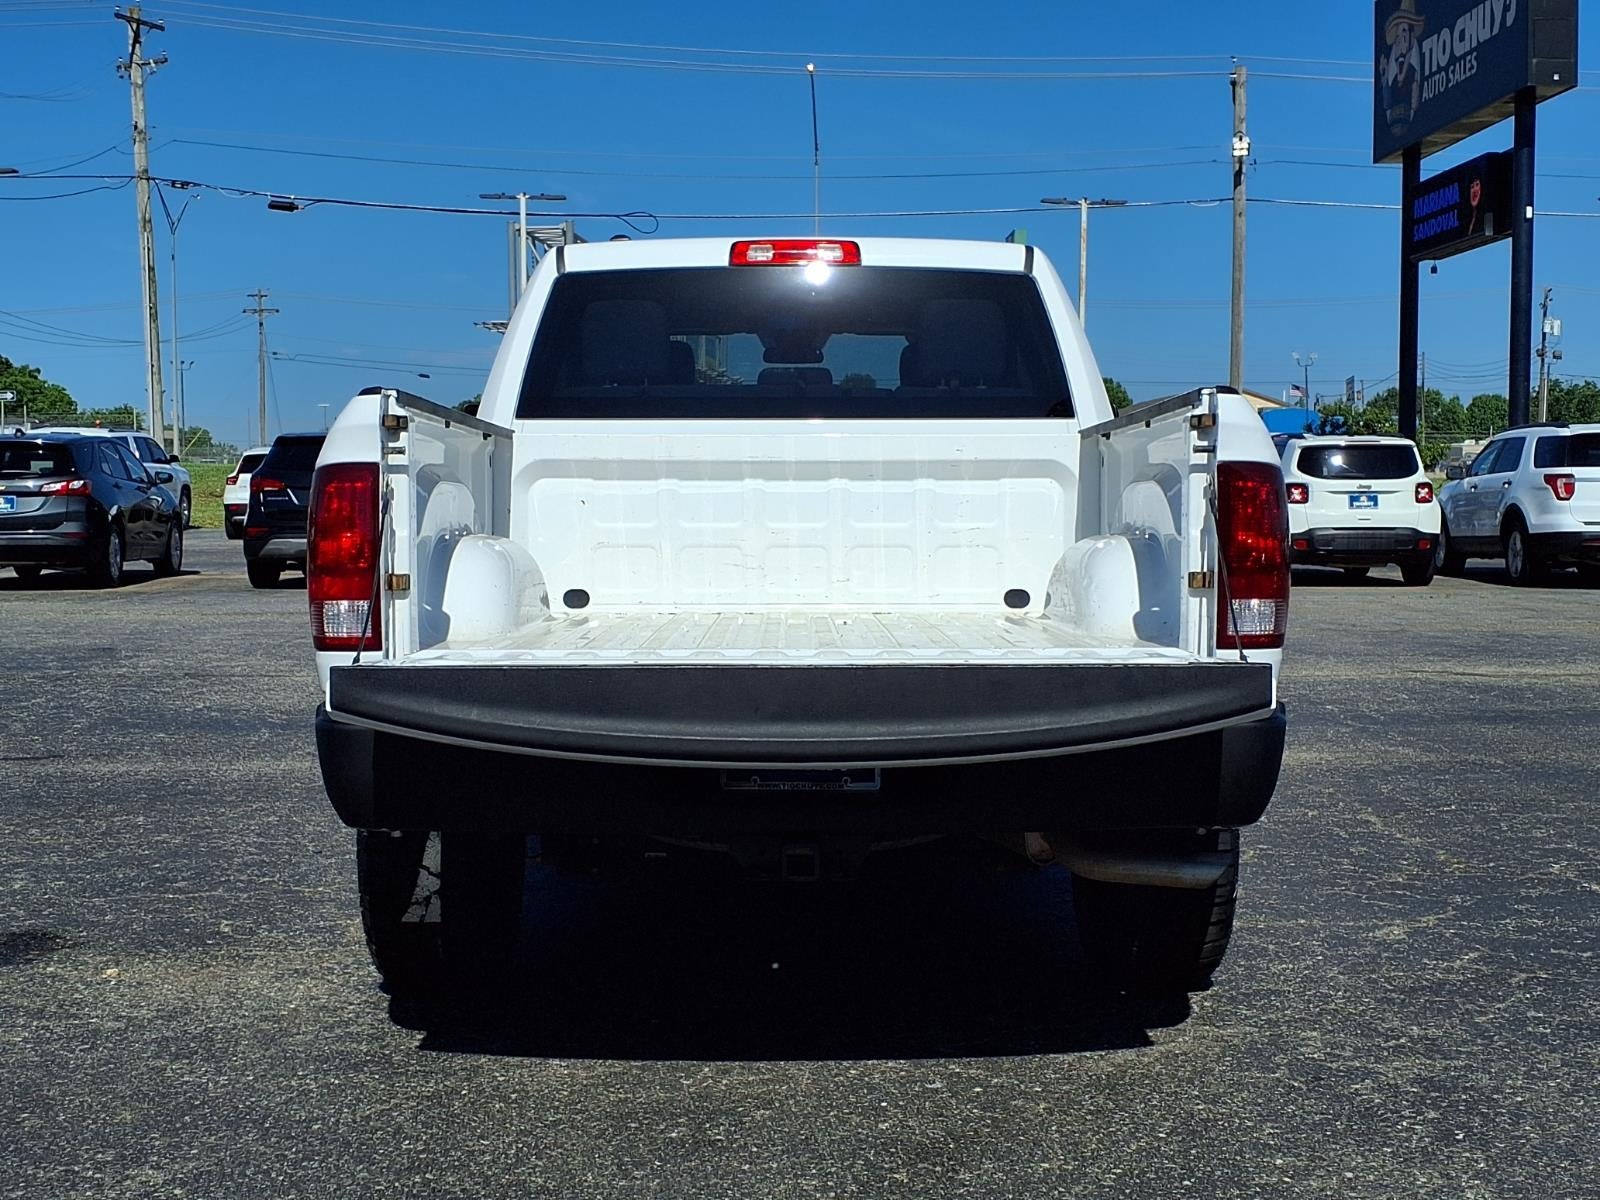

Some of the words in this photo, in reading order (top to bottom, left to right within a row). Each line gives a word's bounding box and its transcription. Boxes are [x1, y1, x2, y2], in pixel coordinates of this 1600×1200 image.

[1422, 27, 1451, 76] TIO
[1452, 0, 1517, 57] CHUYS
[1421, 71, 1447, 102] AUTO
[1448, 51, 1478, 88] SALES
[1413, 208, 1460, 241] SANDOVAL
